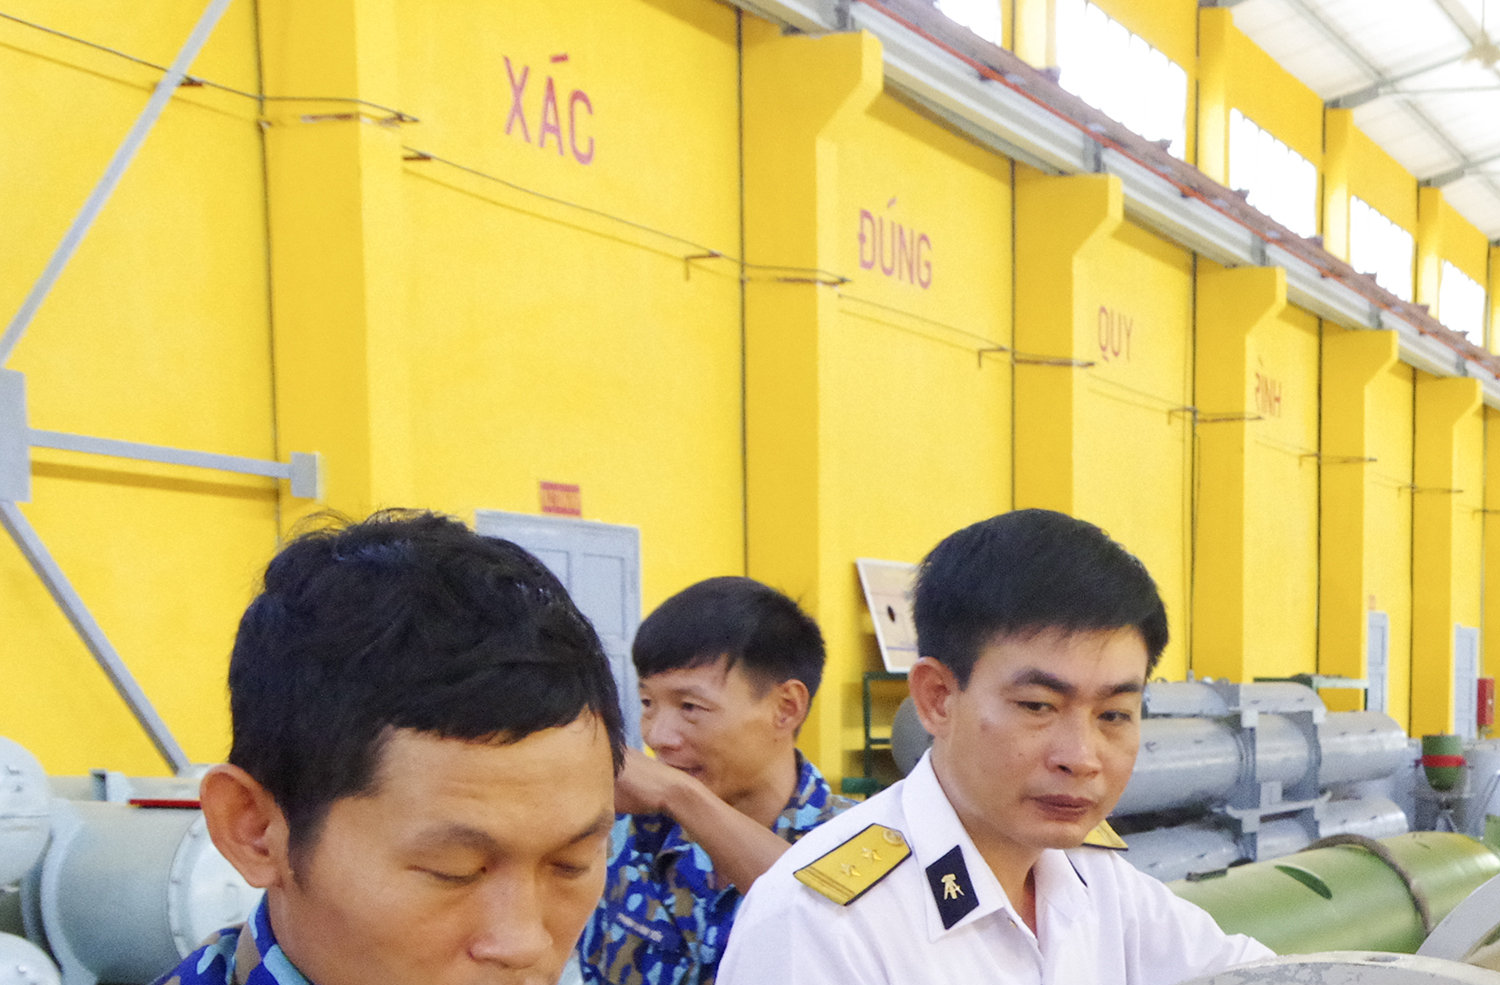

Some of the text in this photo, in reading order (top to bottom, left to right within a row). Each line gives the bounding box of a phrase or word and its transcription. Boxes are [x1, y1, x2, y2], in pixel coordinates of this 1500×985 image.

[503, 53, 596, 166] XÁC
[857, 196, 933, 290] ĐÚNG
[1097, 305, 1134, 363] QUY
